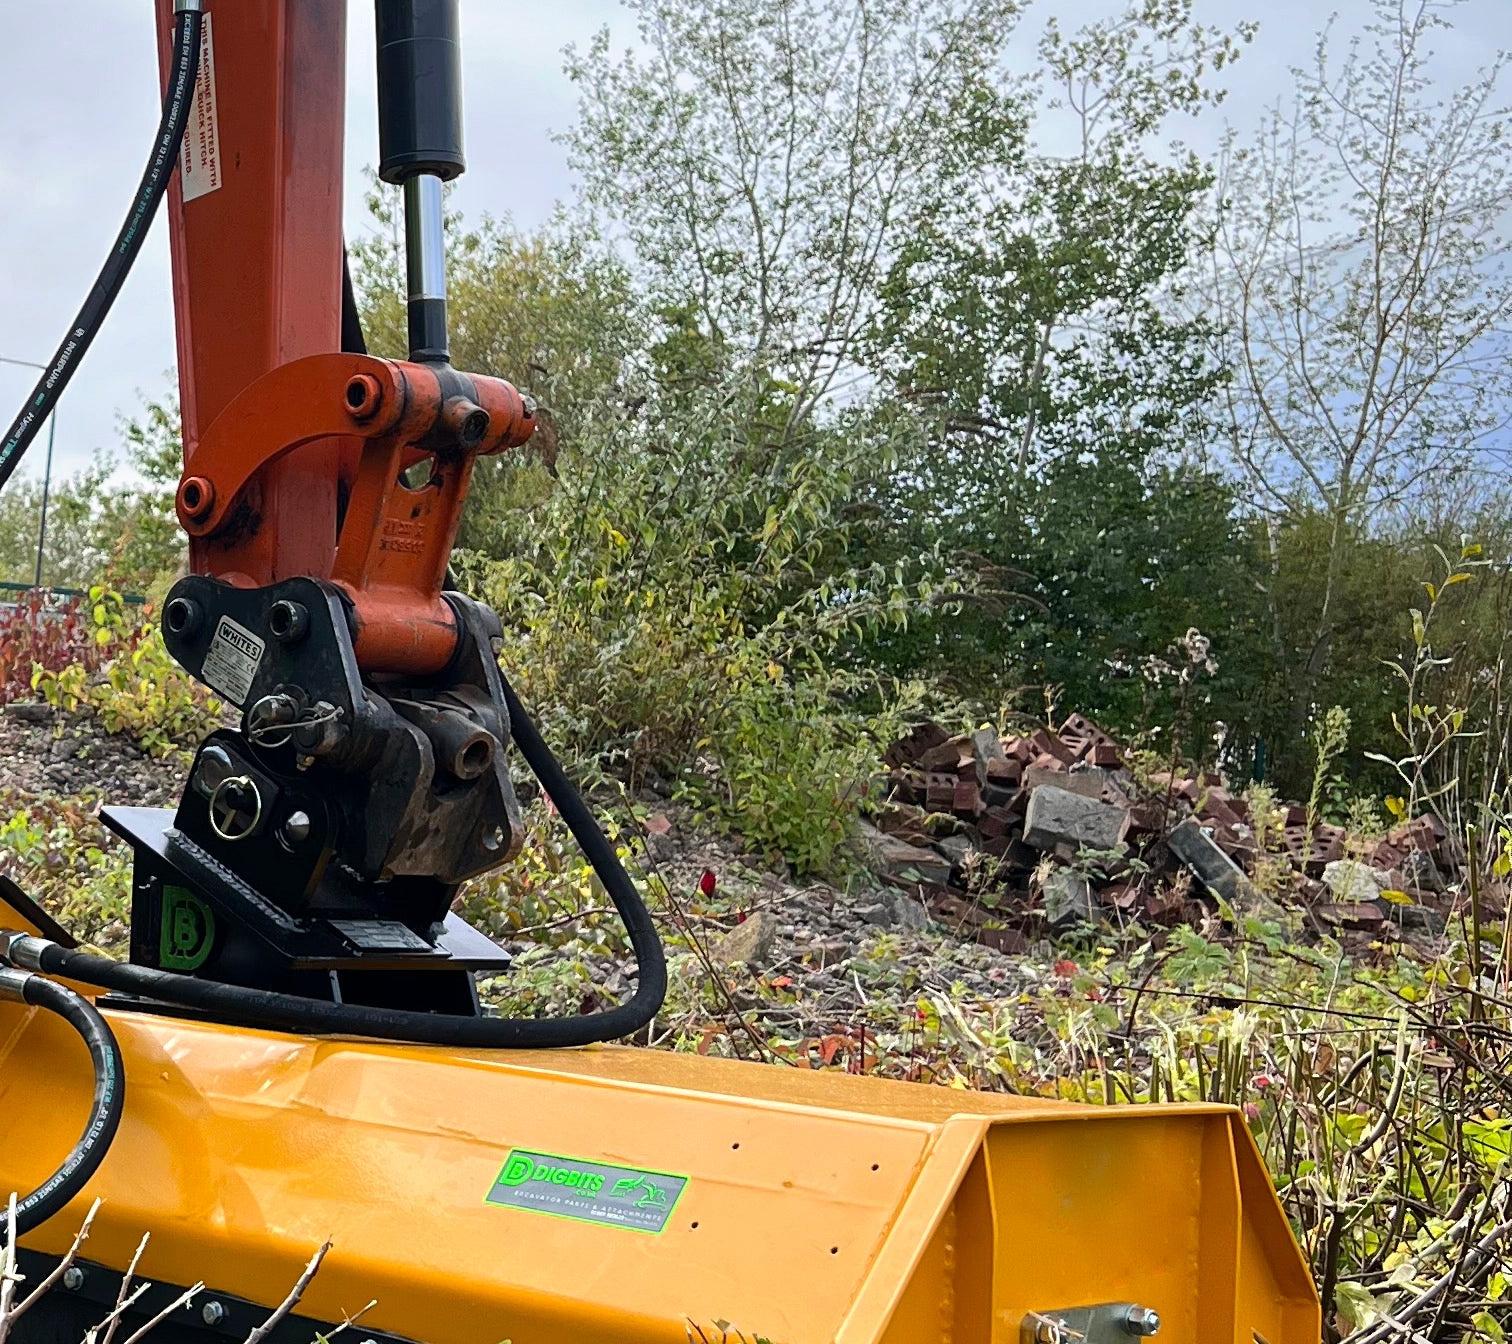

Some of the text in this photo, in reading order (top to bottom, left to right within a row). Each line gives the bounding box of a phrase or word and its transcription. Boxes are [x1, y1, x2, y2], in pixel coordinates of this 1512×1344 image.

[203, 48, 212, 98] MACHINE
[198, 92, 206, 128] QUICK
[206, 100, 212, 114] IS
[209, 156, 217, 187] WITH
[46, 340, 76, 389] INTERPUMP
[222, 626, 258, 656] WHITES
[532, 1164, 606, 1192] DIGBITS
